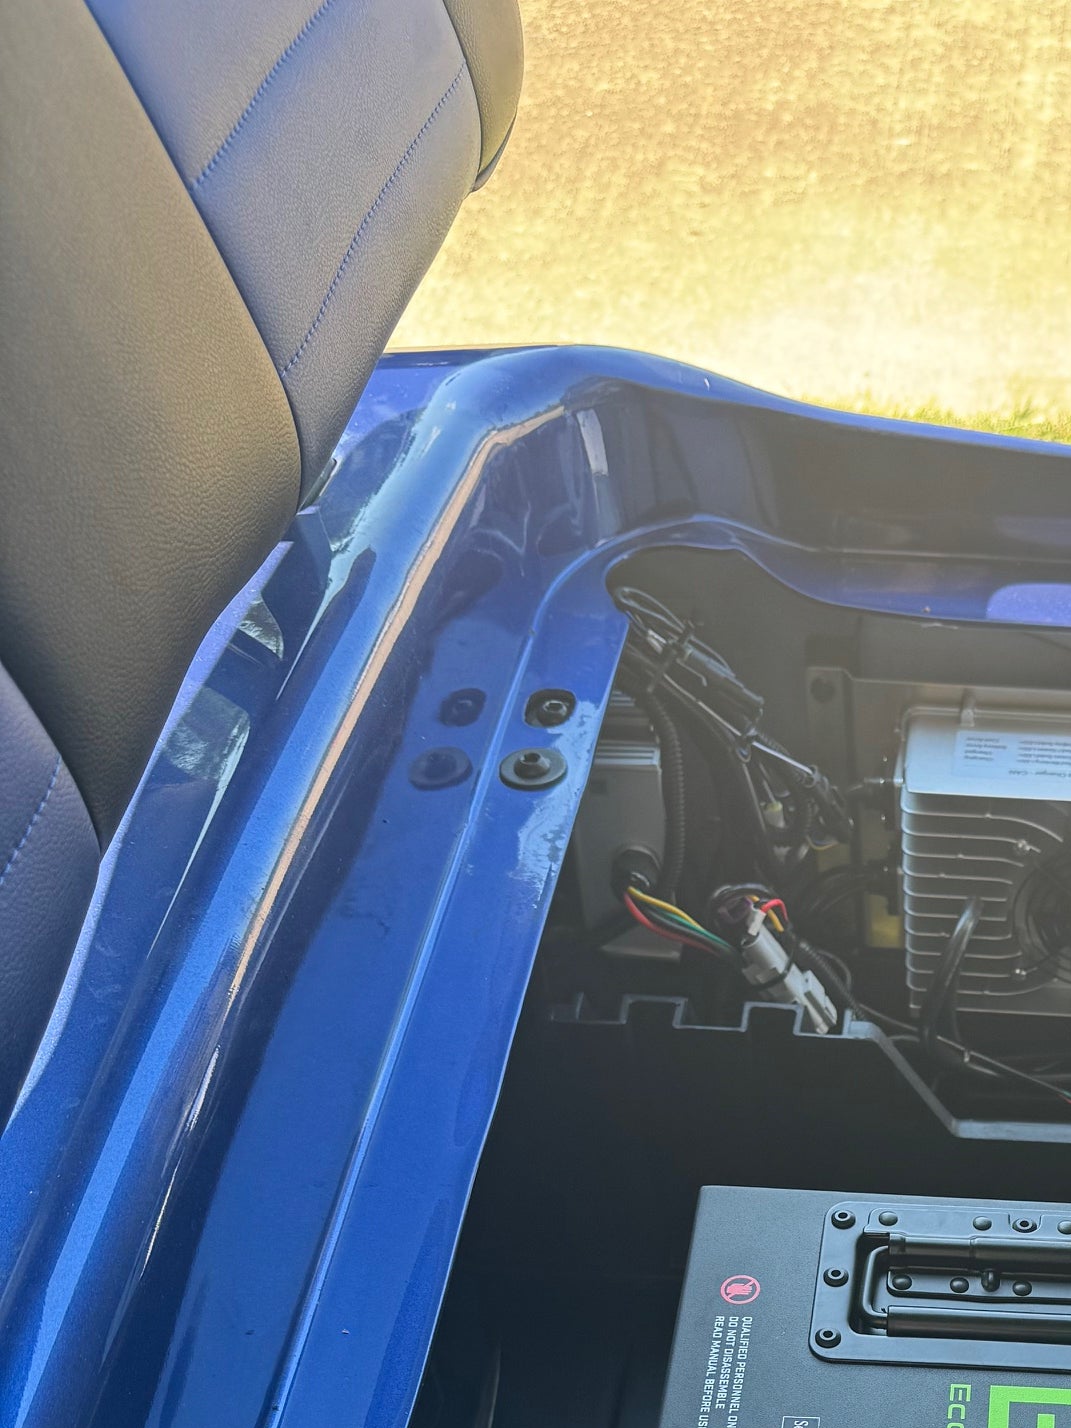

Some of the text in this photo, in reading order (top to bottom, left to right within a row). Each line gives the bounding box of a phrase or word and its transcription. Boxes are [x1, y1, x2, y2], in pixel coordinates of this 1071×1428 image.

[713, 1316, 725, 1338] READ
[738, 1317, 752, 1359] QUALIFIED
[706, 1341, 721, 1376] MANUAL
[715, 1317, 739, 1409] DO NOT DISASSEMBLE
[700, 1379, 715, 1412] BEFORE
[729, 1362, 746, 1413] PERSONNEL
